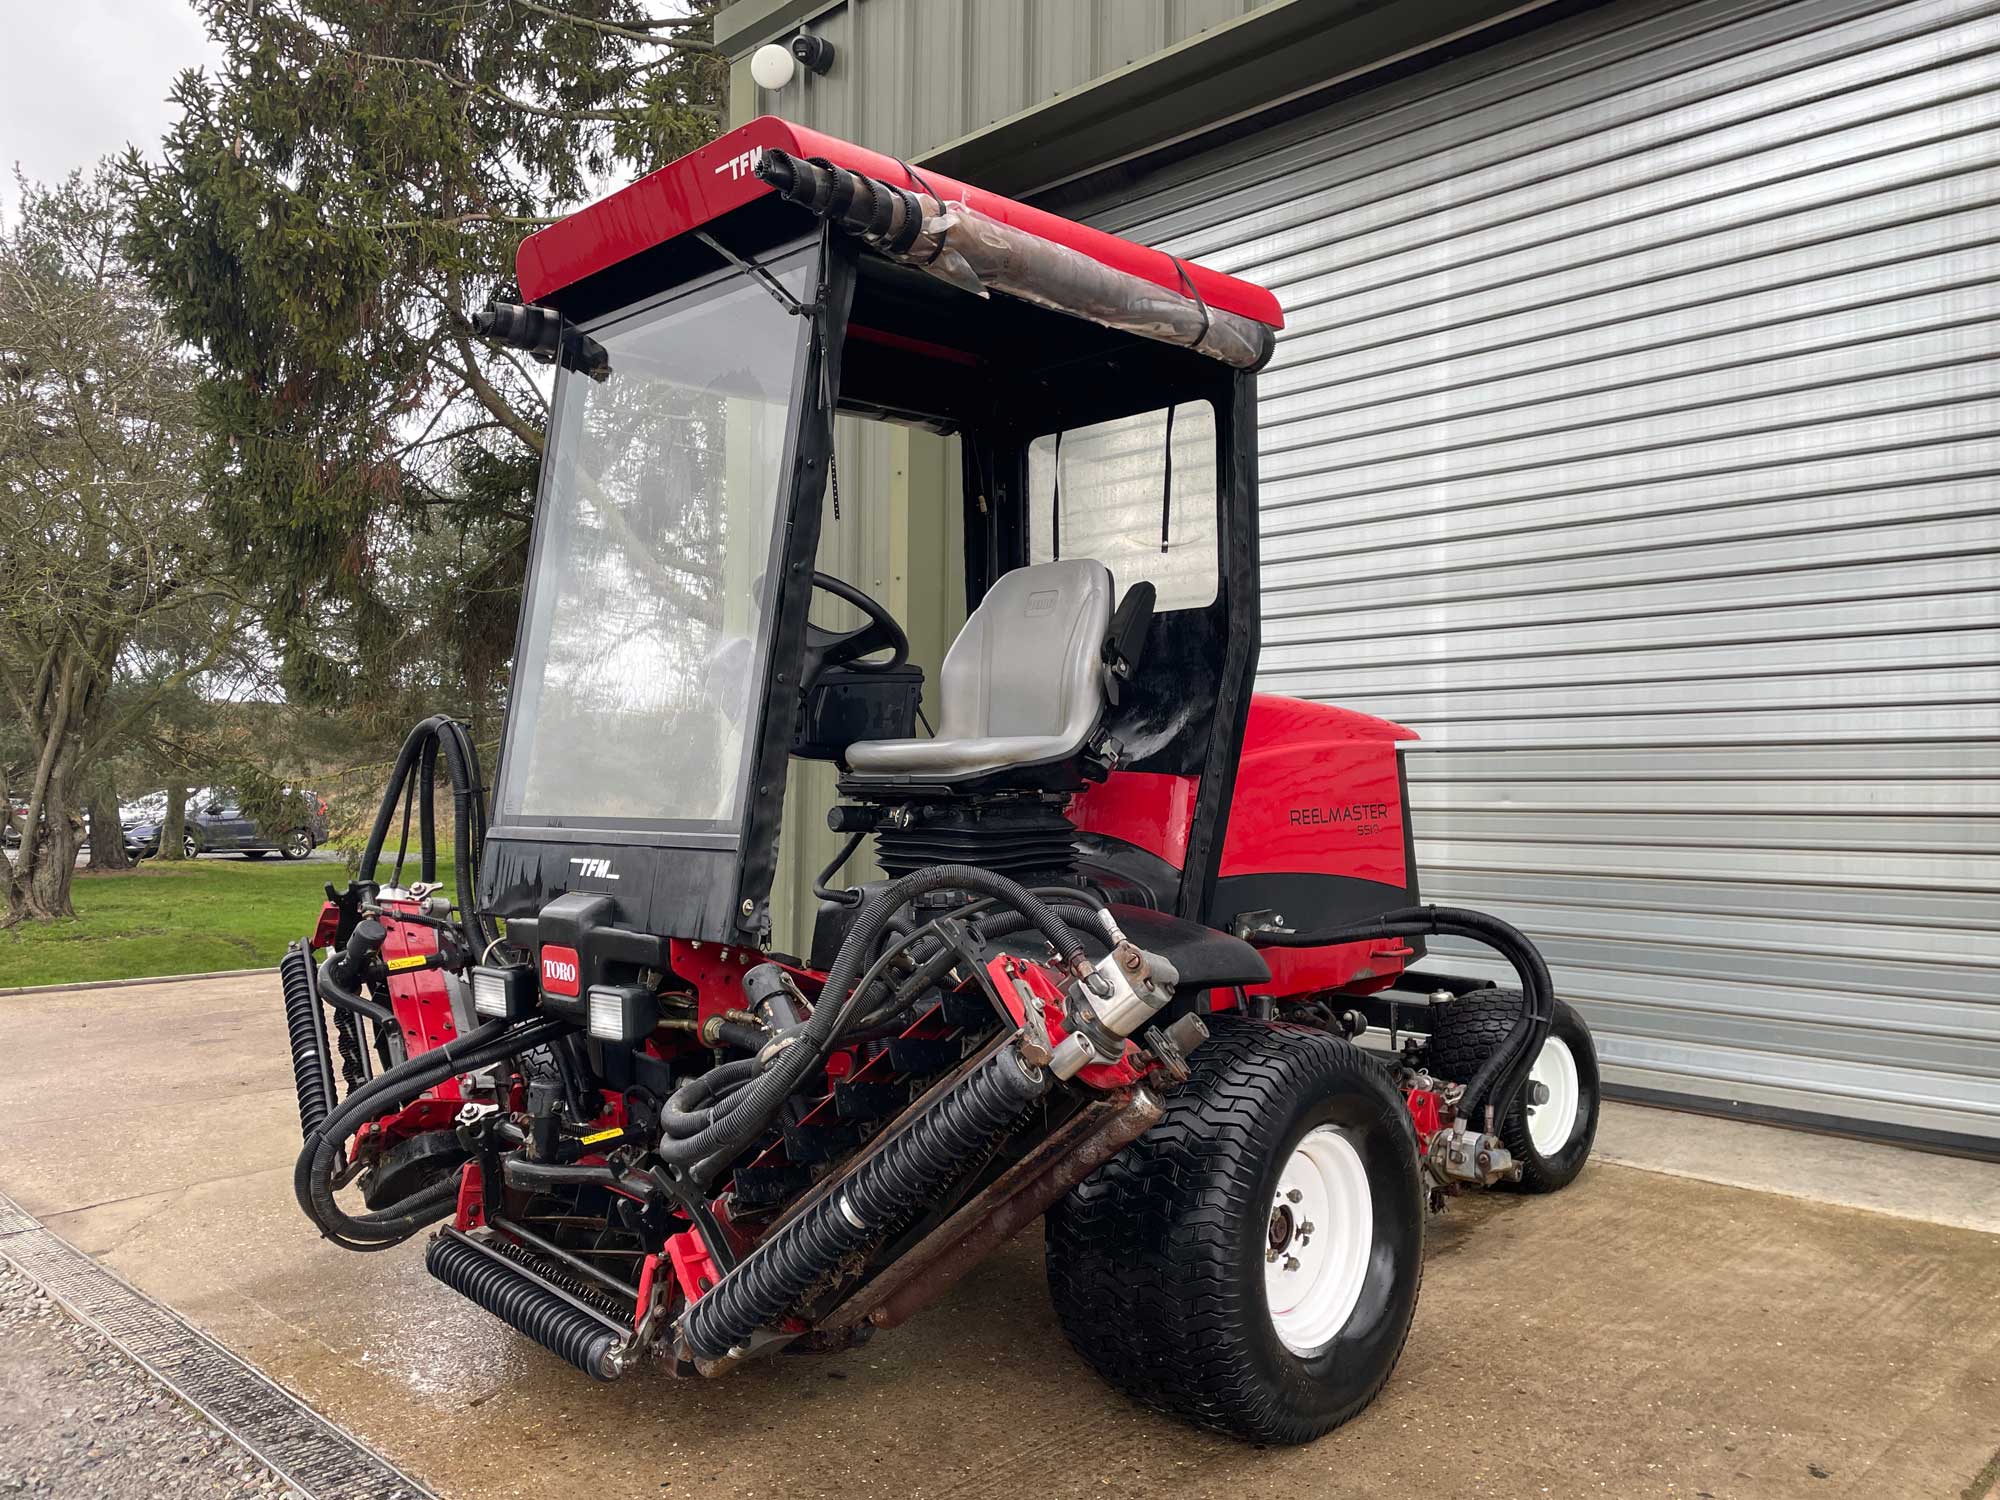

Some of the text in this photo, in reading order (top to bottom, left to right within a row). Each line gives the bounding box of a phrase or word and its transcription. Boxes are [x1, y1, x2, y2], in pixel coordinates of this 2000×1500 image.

[729, 145, 763, 180] TFM
[1290, 803, 1388, 826] REELMASTER
[579, 858, 611, 879] TFM
[543, 959, 576, 982] TORO
